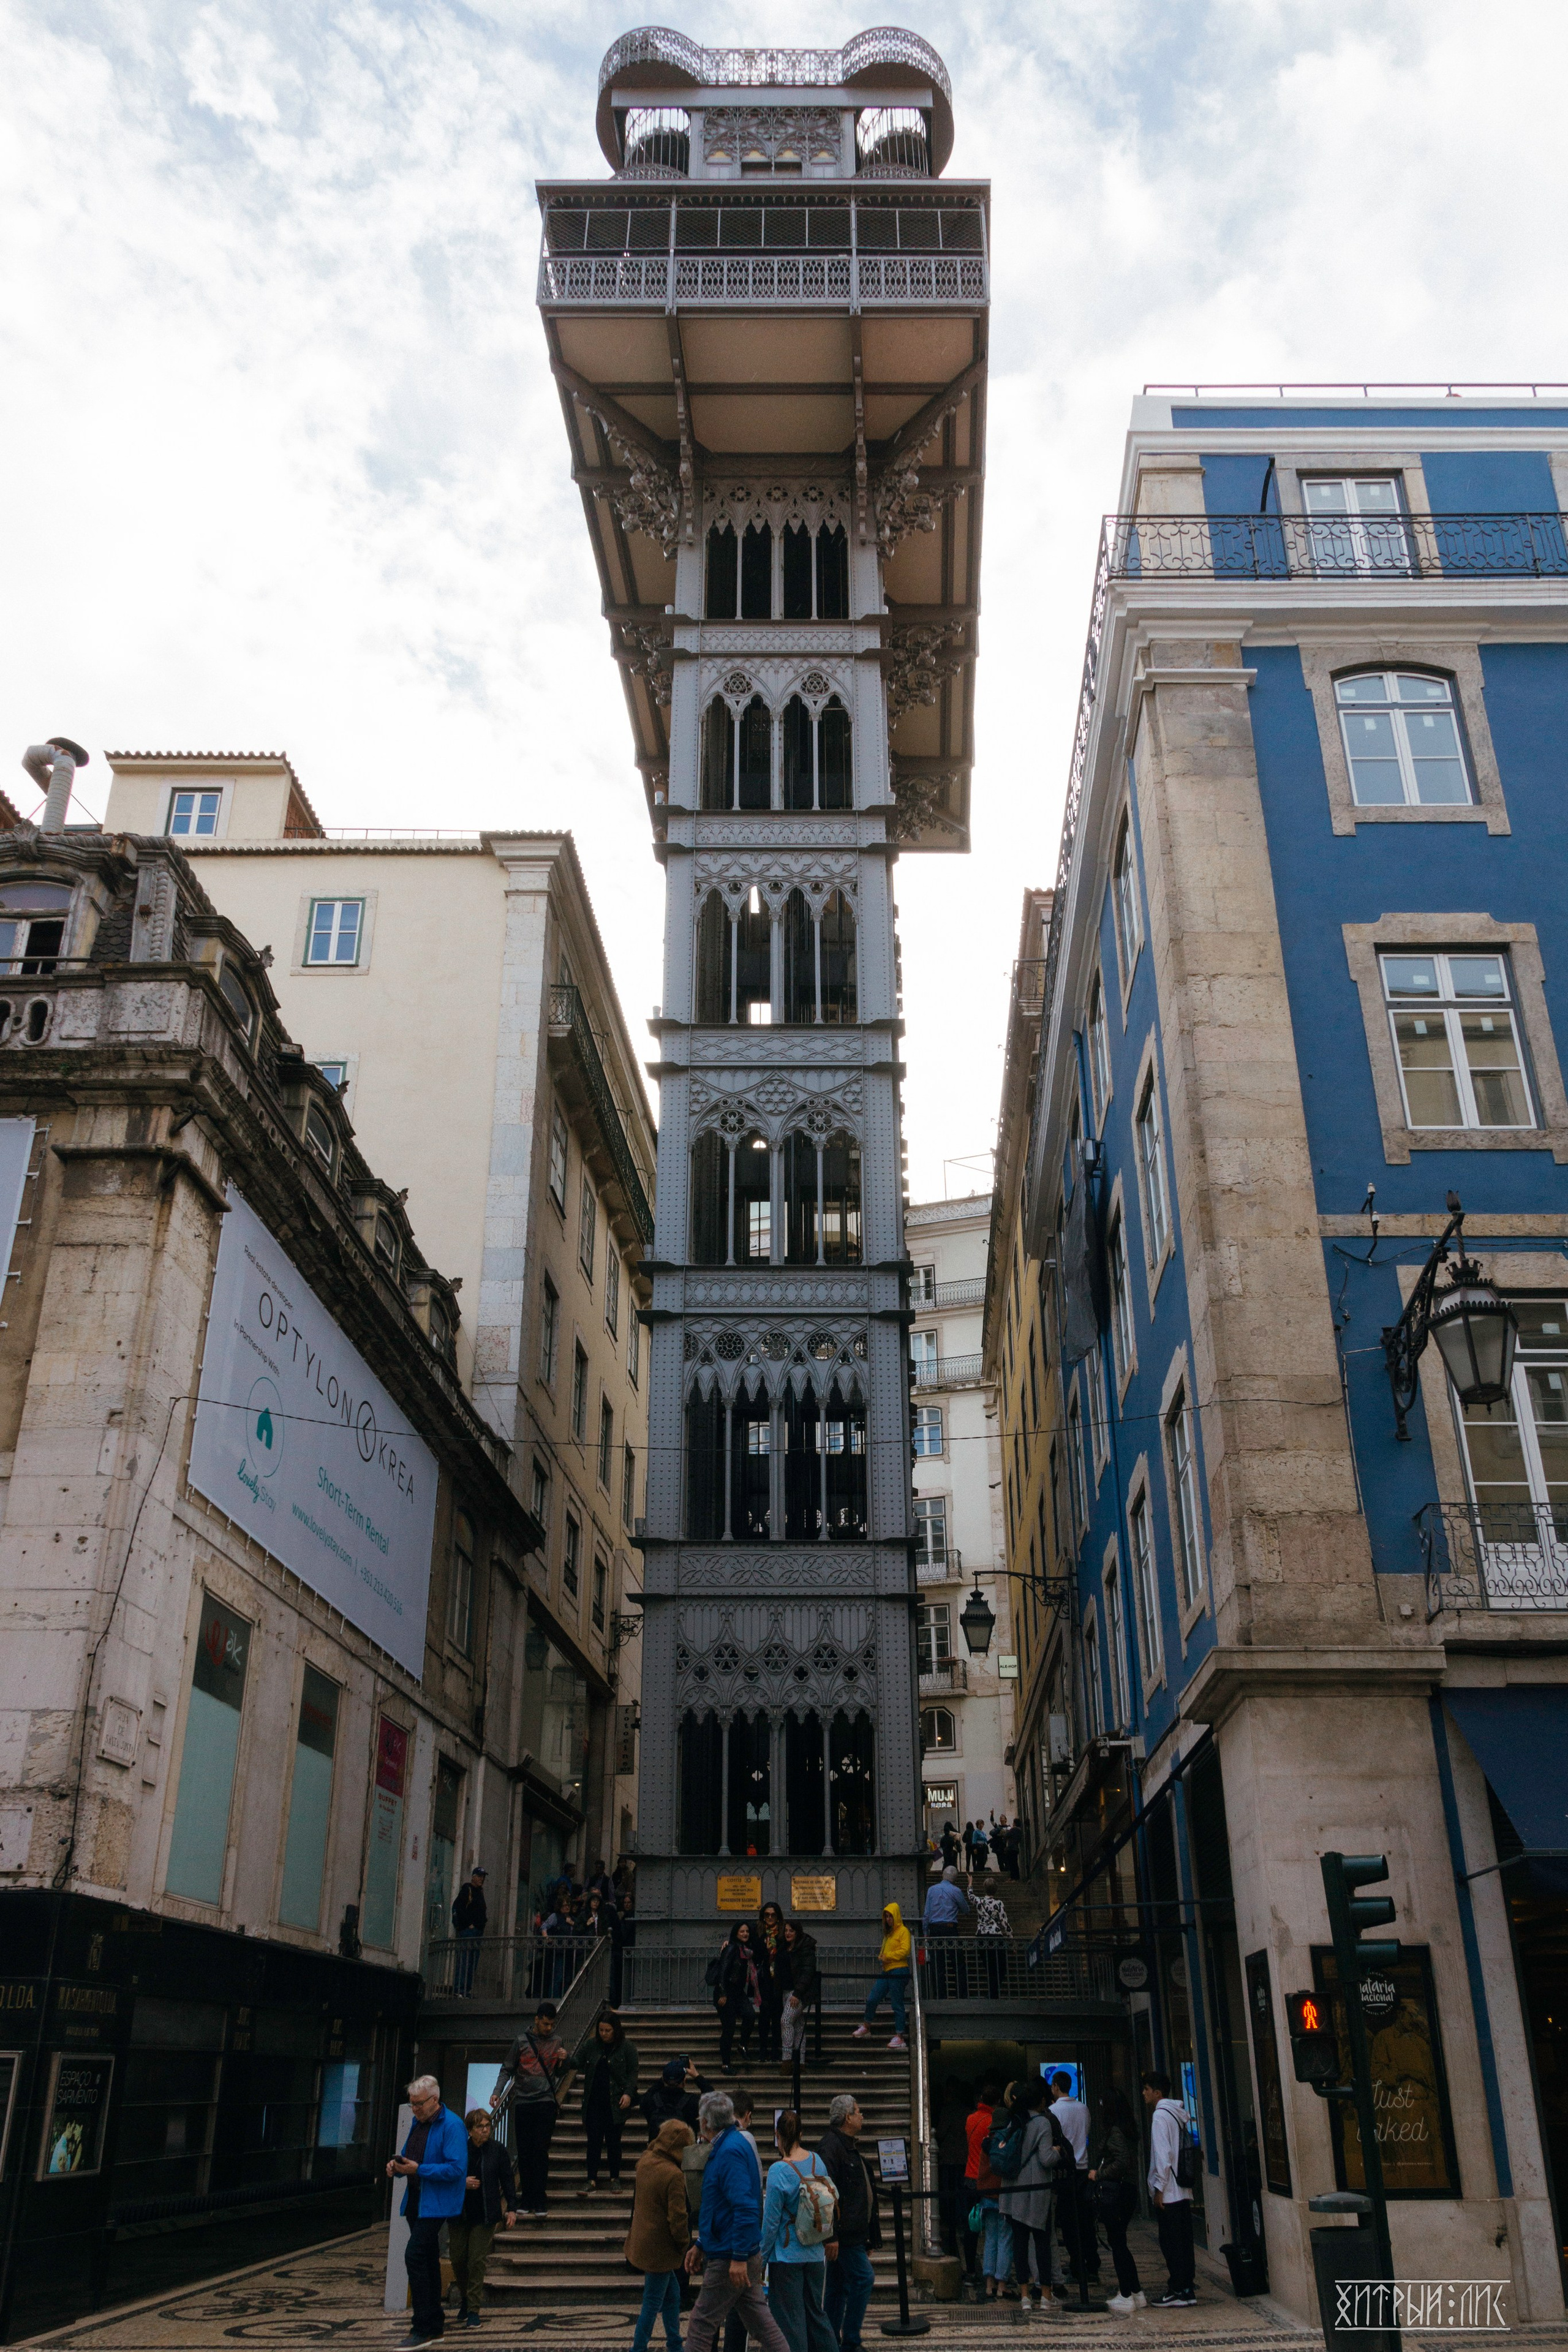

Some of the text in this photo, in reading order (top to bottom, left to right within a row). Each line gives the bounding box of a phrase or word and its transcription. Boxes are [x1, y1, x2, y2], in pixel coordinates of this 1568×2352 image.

[244, 1245, 294, 1313] Real estate developer:
[234, 1318, 280, 1378] In Partnership With:
[259, 1292, 413, 1504] OPTYLON KREA
[292, 1502, 353, 1567] www.lovelystay.com
[317, 1466, 390, 1557] Short-Term Rental
[378, 1793, 398, 1807] BUFFET
[927, 1788, 954, 1802] MUJI
[56, 2088, 99, 2105] SARMENTO
[59, 2070, 92, 2089] ESPAÇO
